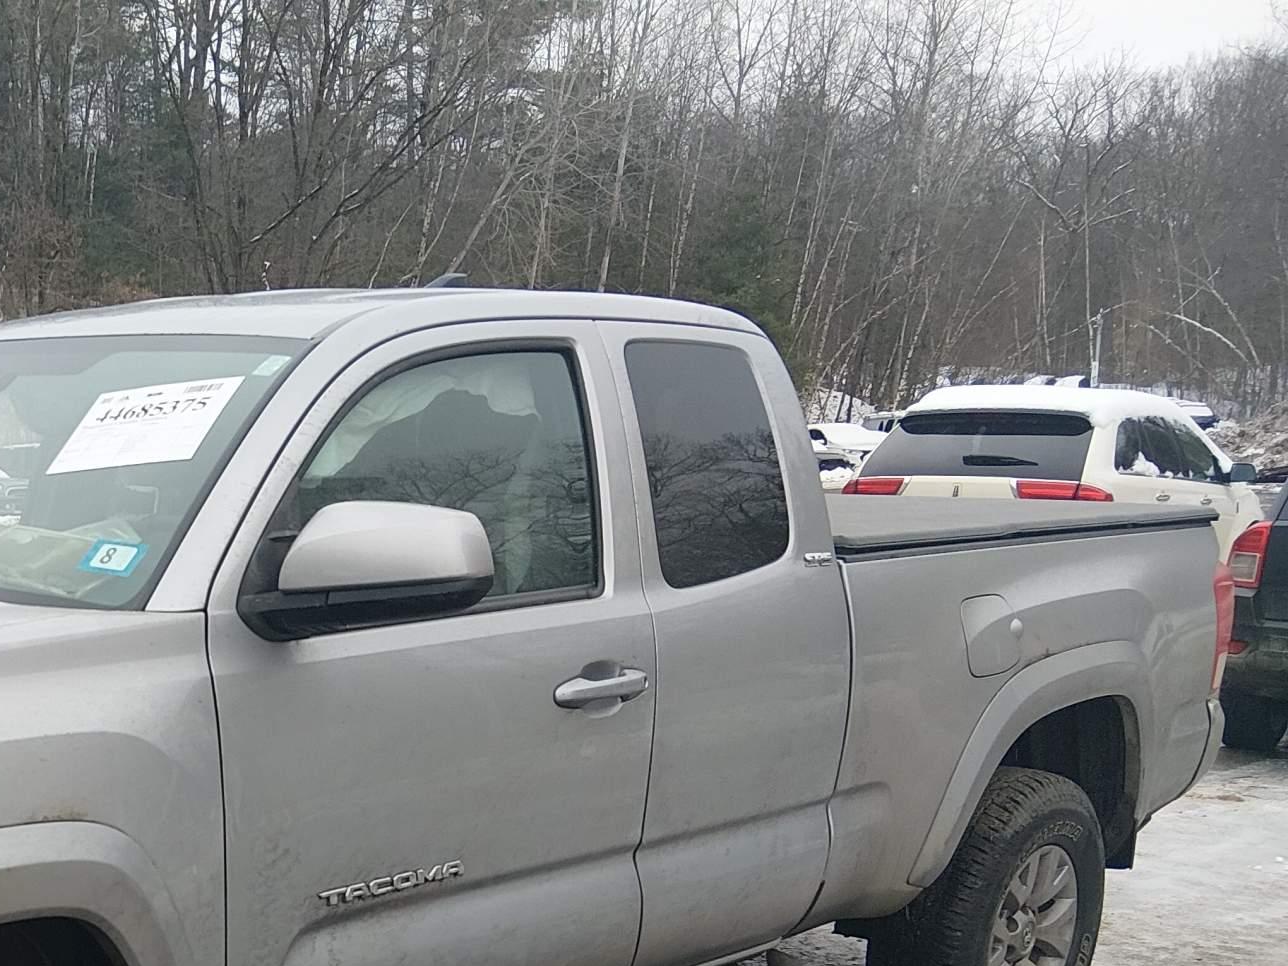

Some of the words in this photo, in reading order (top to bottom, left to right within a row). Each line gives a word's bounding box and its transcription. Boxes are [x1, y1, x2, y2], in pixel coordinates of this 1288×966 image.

[96, 396, 211, 422] 44685375
[99, 547, 117, 564] 8
[317, 859, 465, 906] TACOMA
